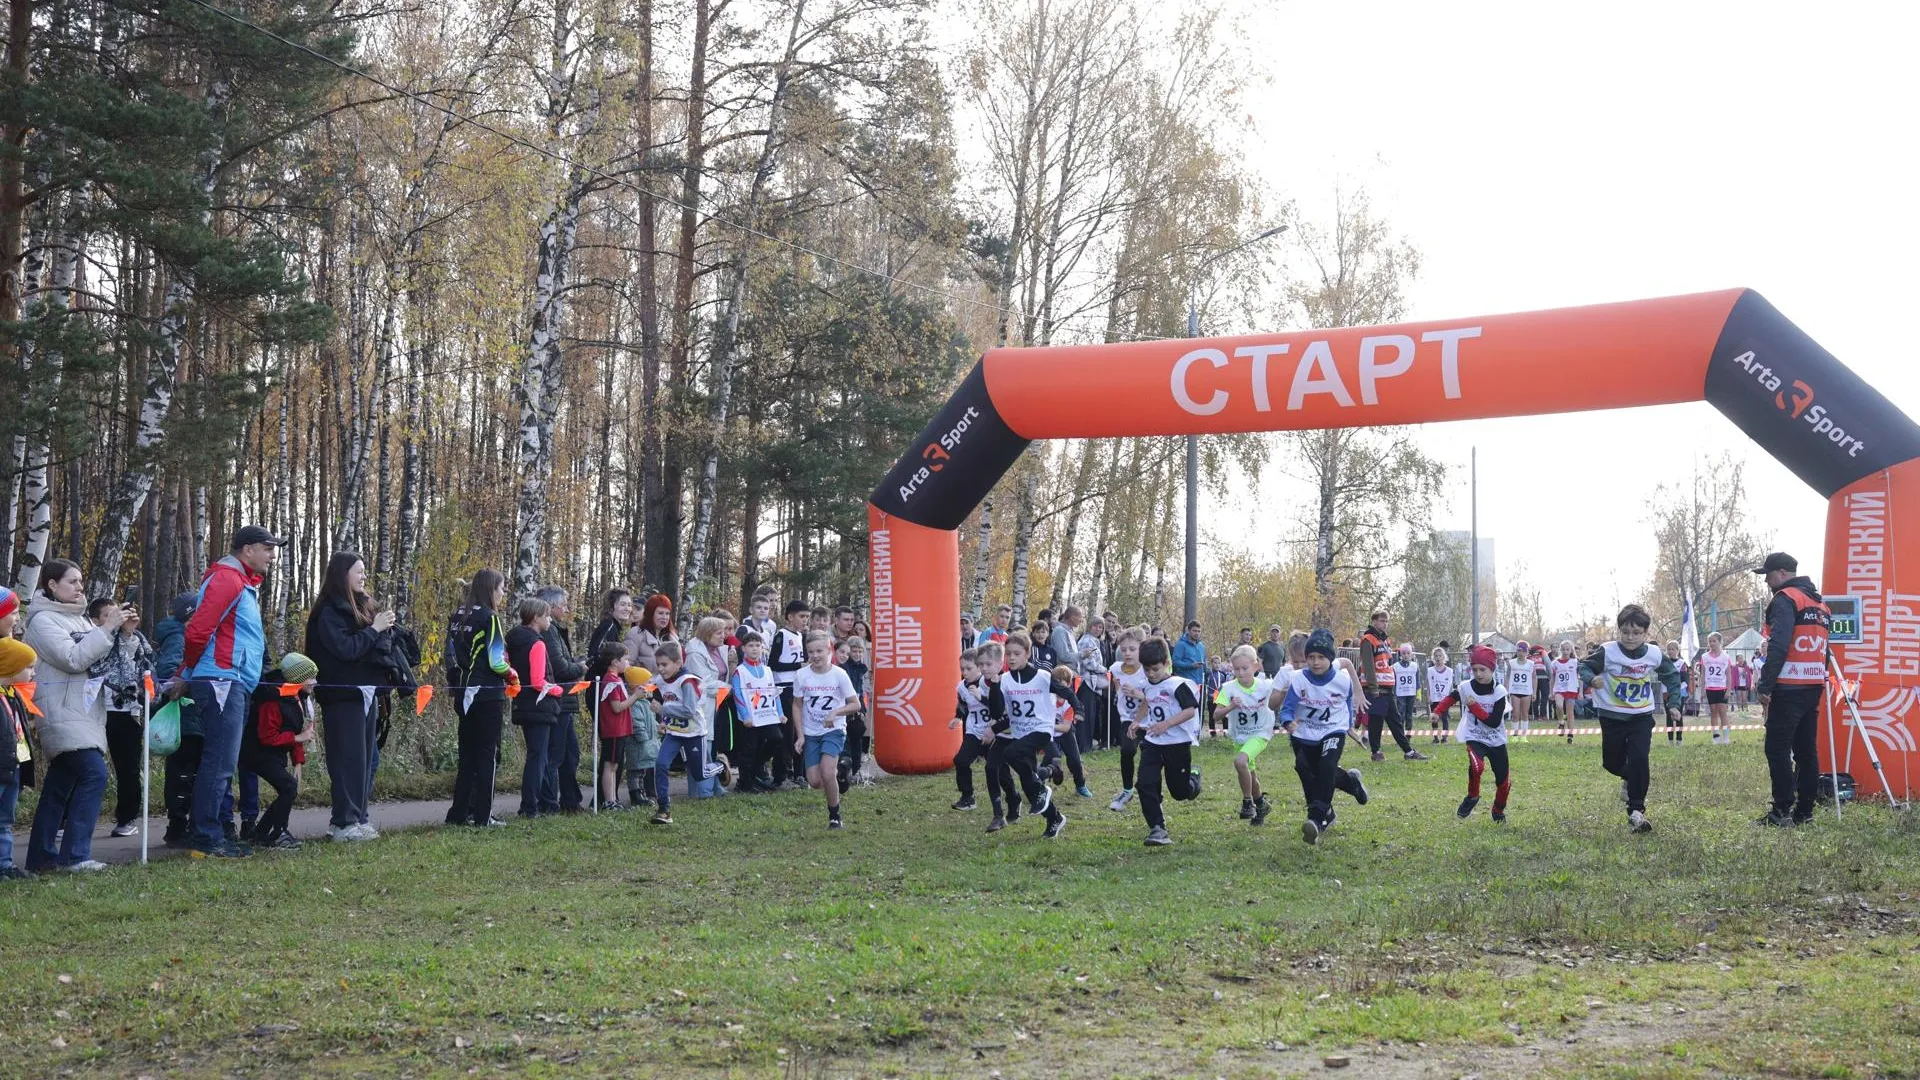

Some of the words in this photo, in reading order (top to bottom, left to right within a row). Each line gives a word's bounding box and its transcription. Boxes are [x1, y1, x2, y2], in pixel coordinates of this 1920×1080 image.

[1170, 326, 1482, 416] СТАРТ
[1733, 350, 1782, 392] Arta
[1804, 405, 1864, 457] Sport
[899, 466, 930, 502] Arta
[941, 406, 980, 451] Sport
[871, 530, 894, 669] МОСКОВСКИЙ
[895, 603, 923, 669] СПОРТ
[1884, 588, 1920, 676] СПОРТ
[1514, 673, 1528, 683] 89
[1558, 673, 1570, 682] 90
[1709, 666, 1722, 676] 92
[1400, 676, 1413, 685] 98
[1615, 681, 1651, 703] 424
[810, 695, 834, 711] 72
[1011, 700, 1036, 718] 82
[1238, 711, 1259, 725] 81
[1305, 705, 1331, 722] 74
